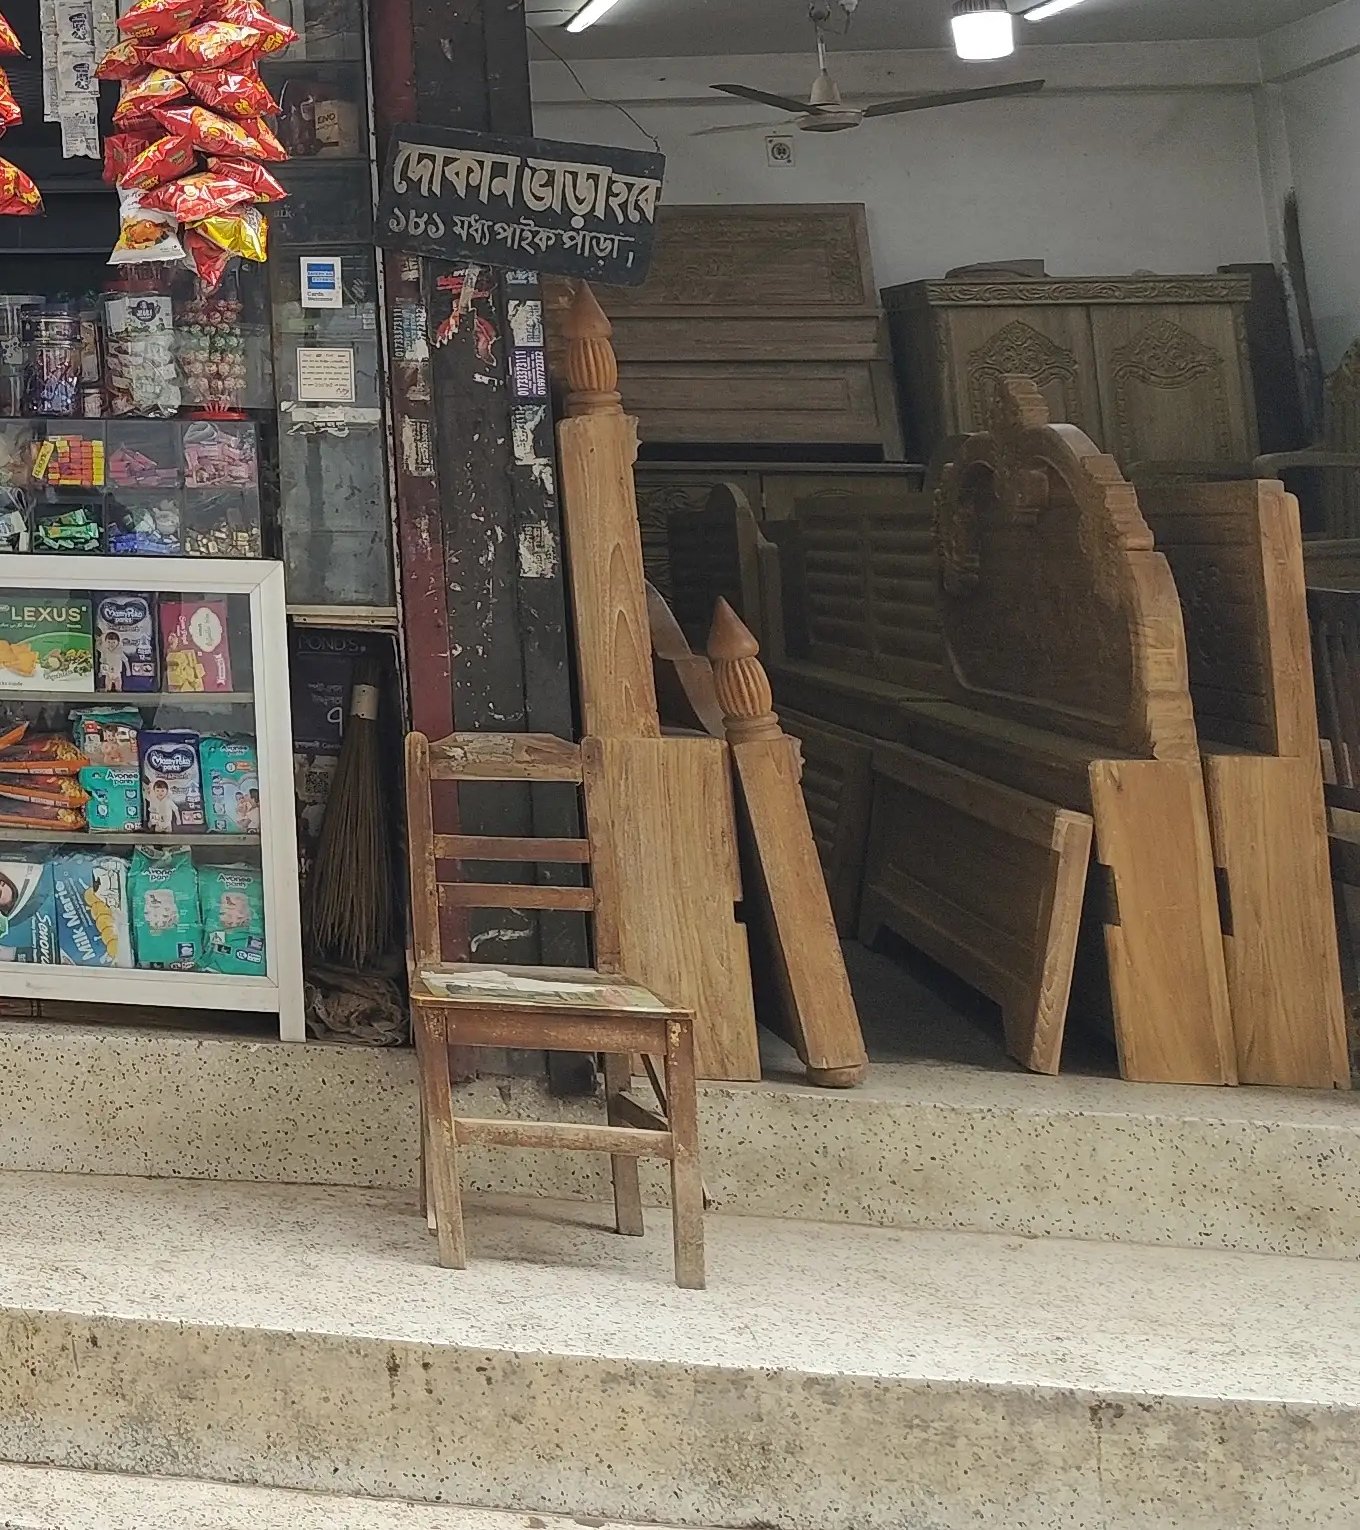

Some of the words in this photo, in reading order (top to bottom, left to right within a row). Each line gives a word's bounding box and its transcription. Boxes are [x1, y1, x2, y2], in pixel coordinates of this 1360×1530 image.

[393, 141, 521, 208] দোকান
[521, 156, 613, 229] ভাড়া
[610, 172, 662, 225] হবে
[388, 207, 446, 239] ১৮১
[452, 213, 494, 247] মধ্য
[11, 604, 83, 622] LEXUS
[55, 879, 82, 928] Marie
[71, 924, 97, 963] Milk
